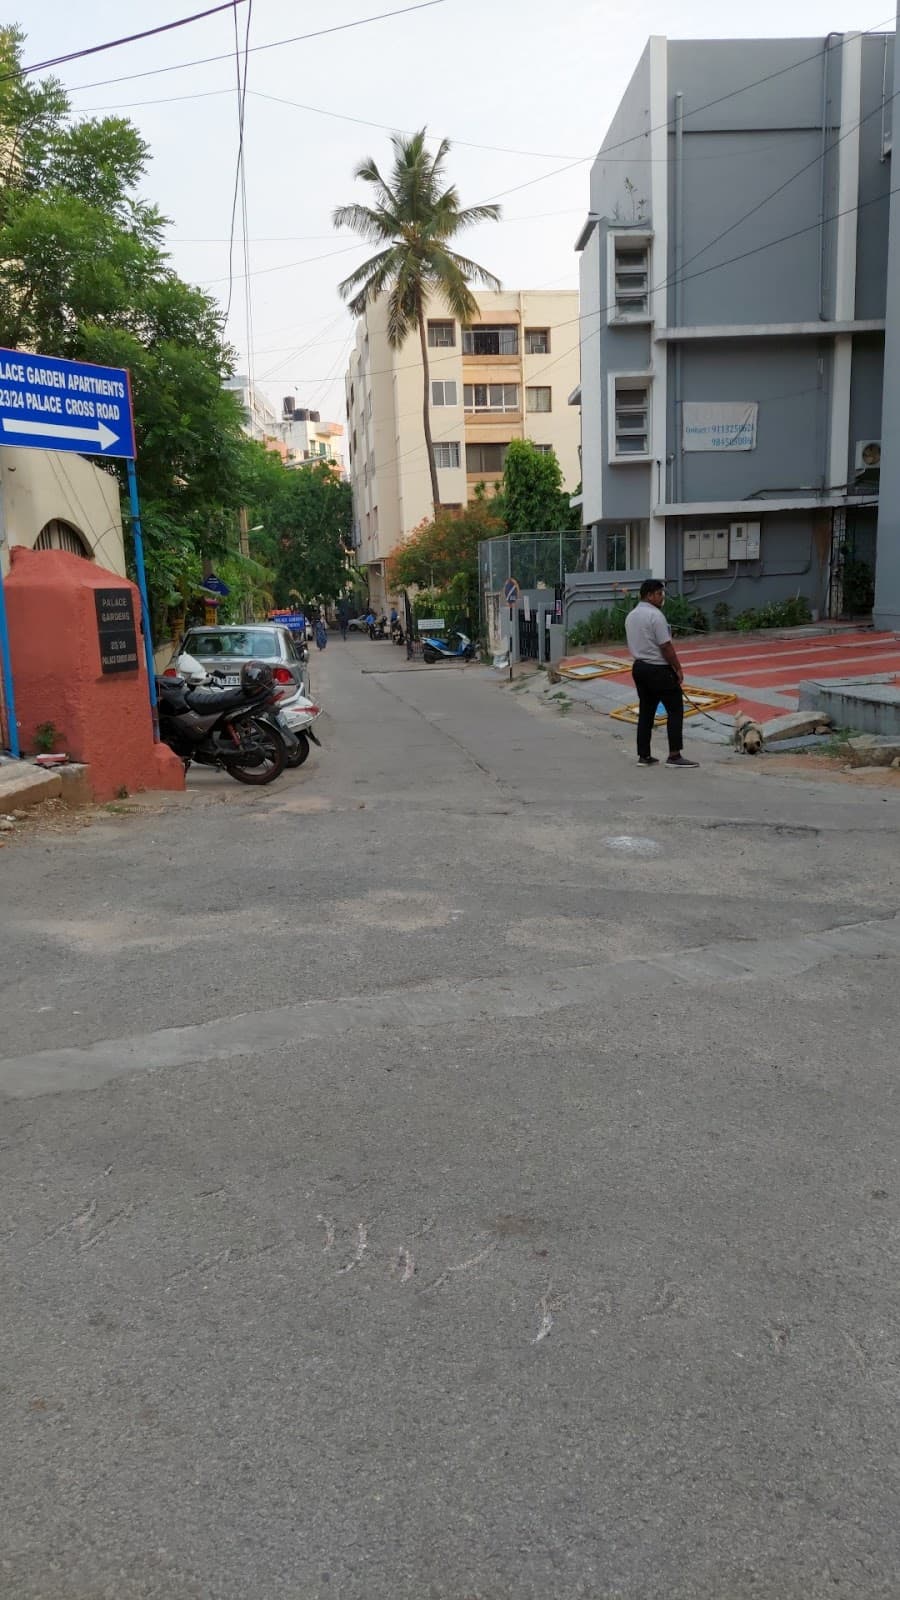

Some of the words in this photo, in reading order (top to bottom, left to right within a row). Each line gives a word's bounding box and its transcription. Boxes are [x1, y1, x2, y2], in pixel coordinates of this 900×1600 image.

[26, 366, 66, 389] GARDEN
[68, 373, 125, 398] APARTMENTS
[26, 392, 62, 414] PALACE
[65, 398, 95, 418] CROSS
[96, 403, 120, 421] ROAD
